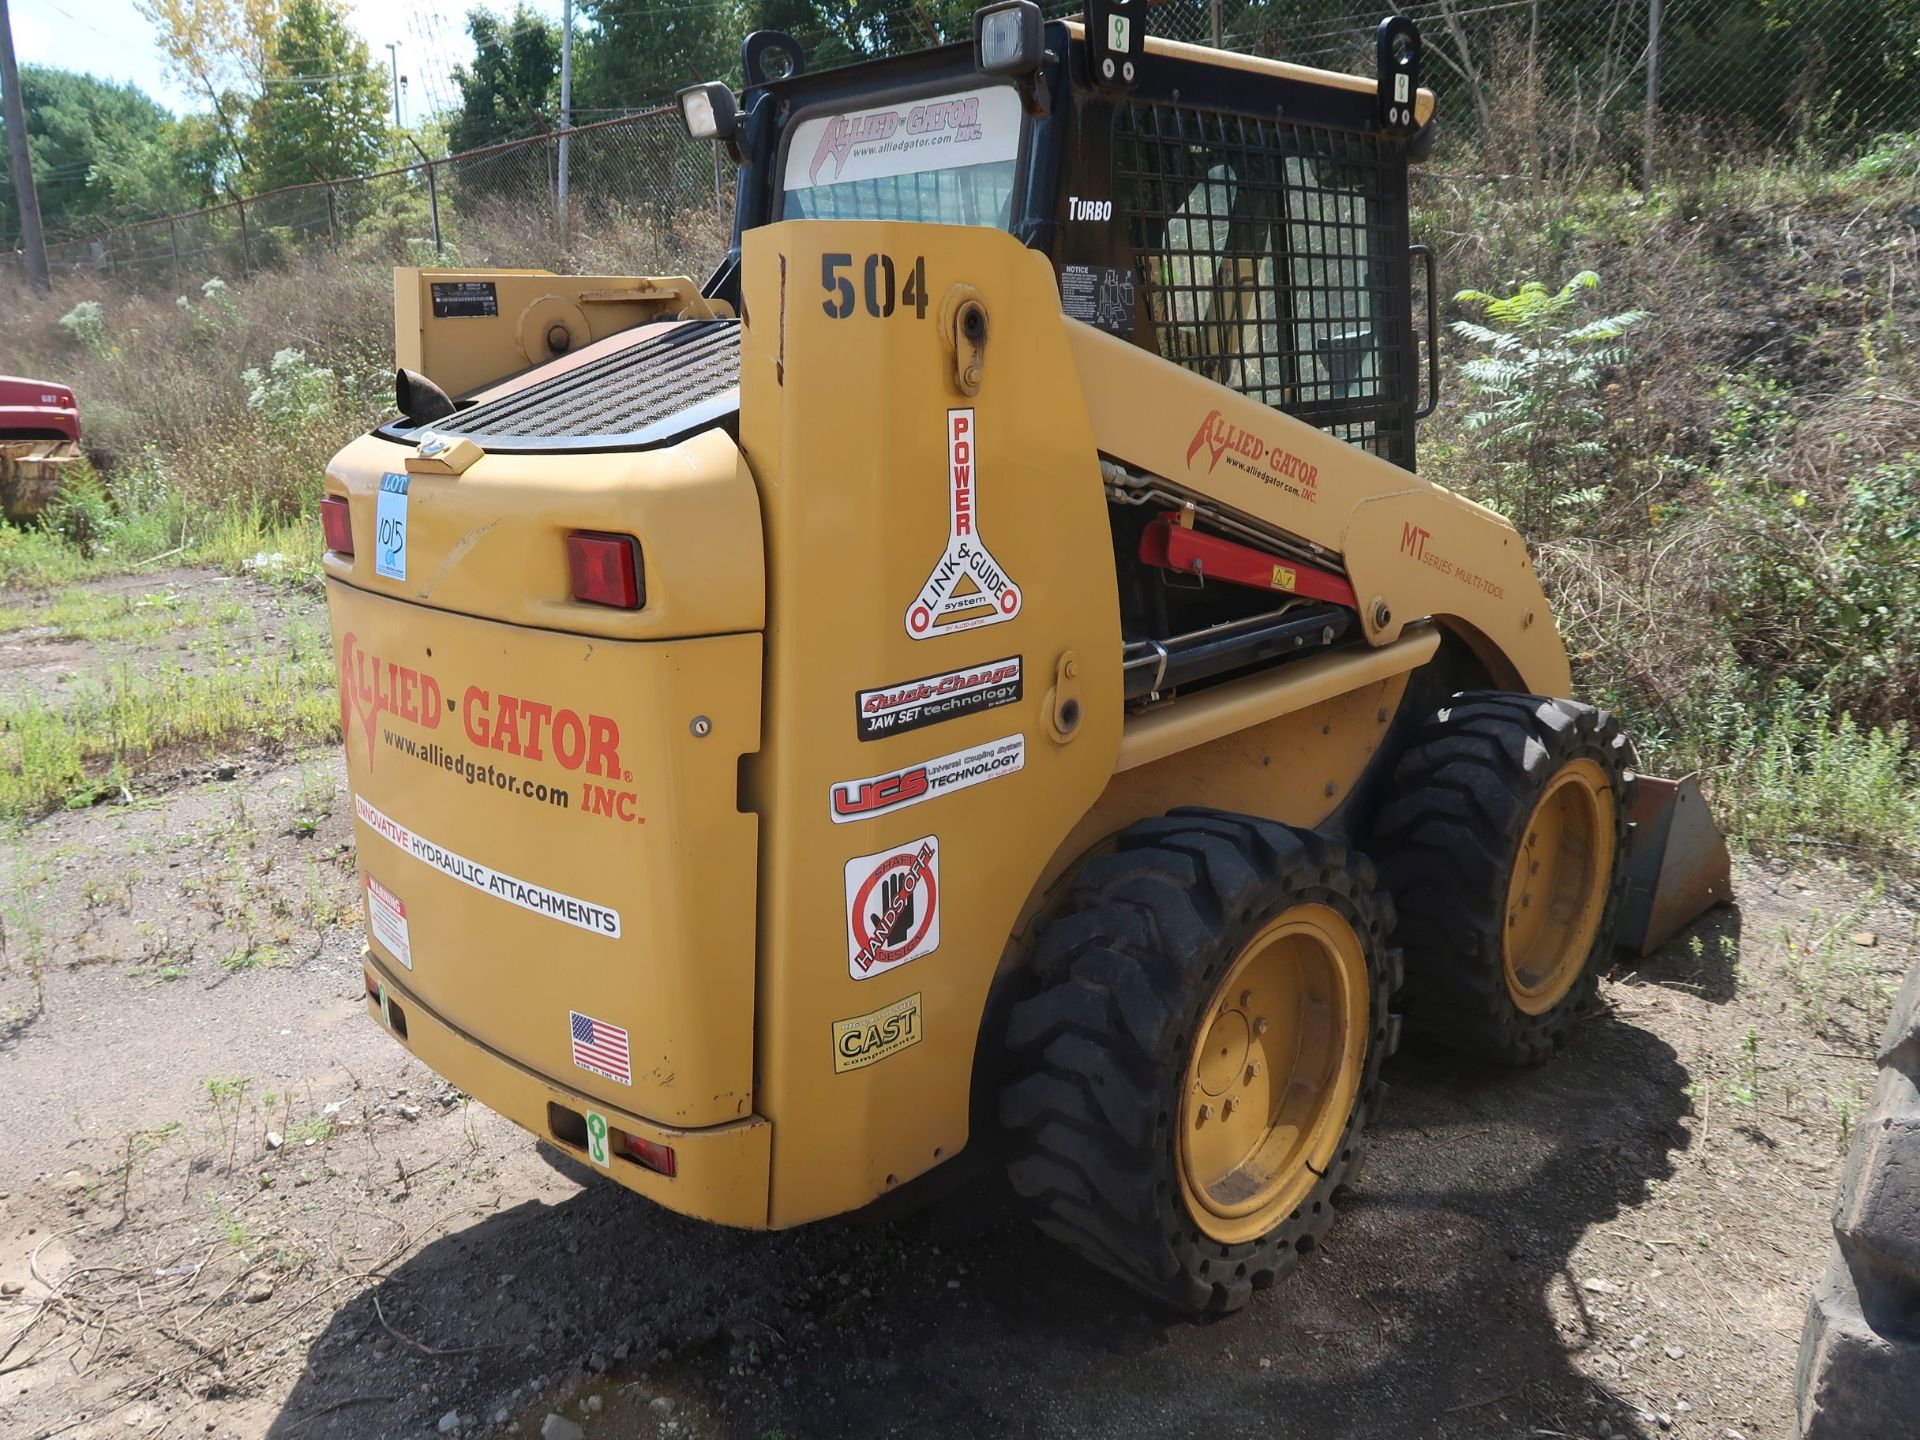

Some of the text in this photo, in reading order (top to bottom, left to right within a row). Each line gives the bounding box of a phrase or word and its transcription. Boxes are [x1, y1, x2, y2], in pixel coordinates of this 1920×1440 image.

[809, 97, 980, 187] ALLIED GATOR
[853, 123, 983, 158] www.alliedgator.com INC.
[1068, 196, 1112, 221] TURBO
[821, 252, 929, 320] 504
[1066, 265, 1089, 274] NOTICE
[1186, 410, 1318, 489] ALLIED GATOR
[383, 473, 408, 494] LOT
[953, 417, 971, 537] POWER
[378, 517, 403, 555] 1015
[1400, 521, 1505, 600] MT SERIES MULTI-TOOL
[922, 543, 1008, 611] LINK & GUIDE
[944, 596, 986, 610] system
[341, 632, 442, 774] ALLIED
[863, 664, 1019, 713] Quick-Change
[867, 713, 896, 731] JAW
[898, 707, 922, 724] SET
[924, 685, 1017, 716] technology
[383, 727, 646, 825] www.alliedgator.com INC.
[834, 752, 1020, 815] UCS TECHNOLOGY
[356, 798, 616, 933] INNOVATIVE HYDRAULIC ATTACHMENTS
[874, 855, 914, 878] SHAFT
[369, 877, 401, 913] WARNING
[855, 894, 904, 971] HANDS
[839, 1006, 917, 1058] CAST
[843, 1034, 916, 1067] components
